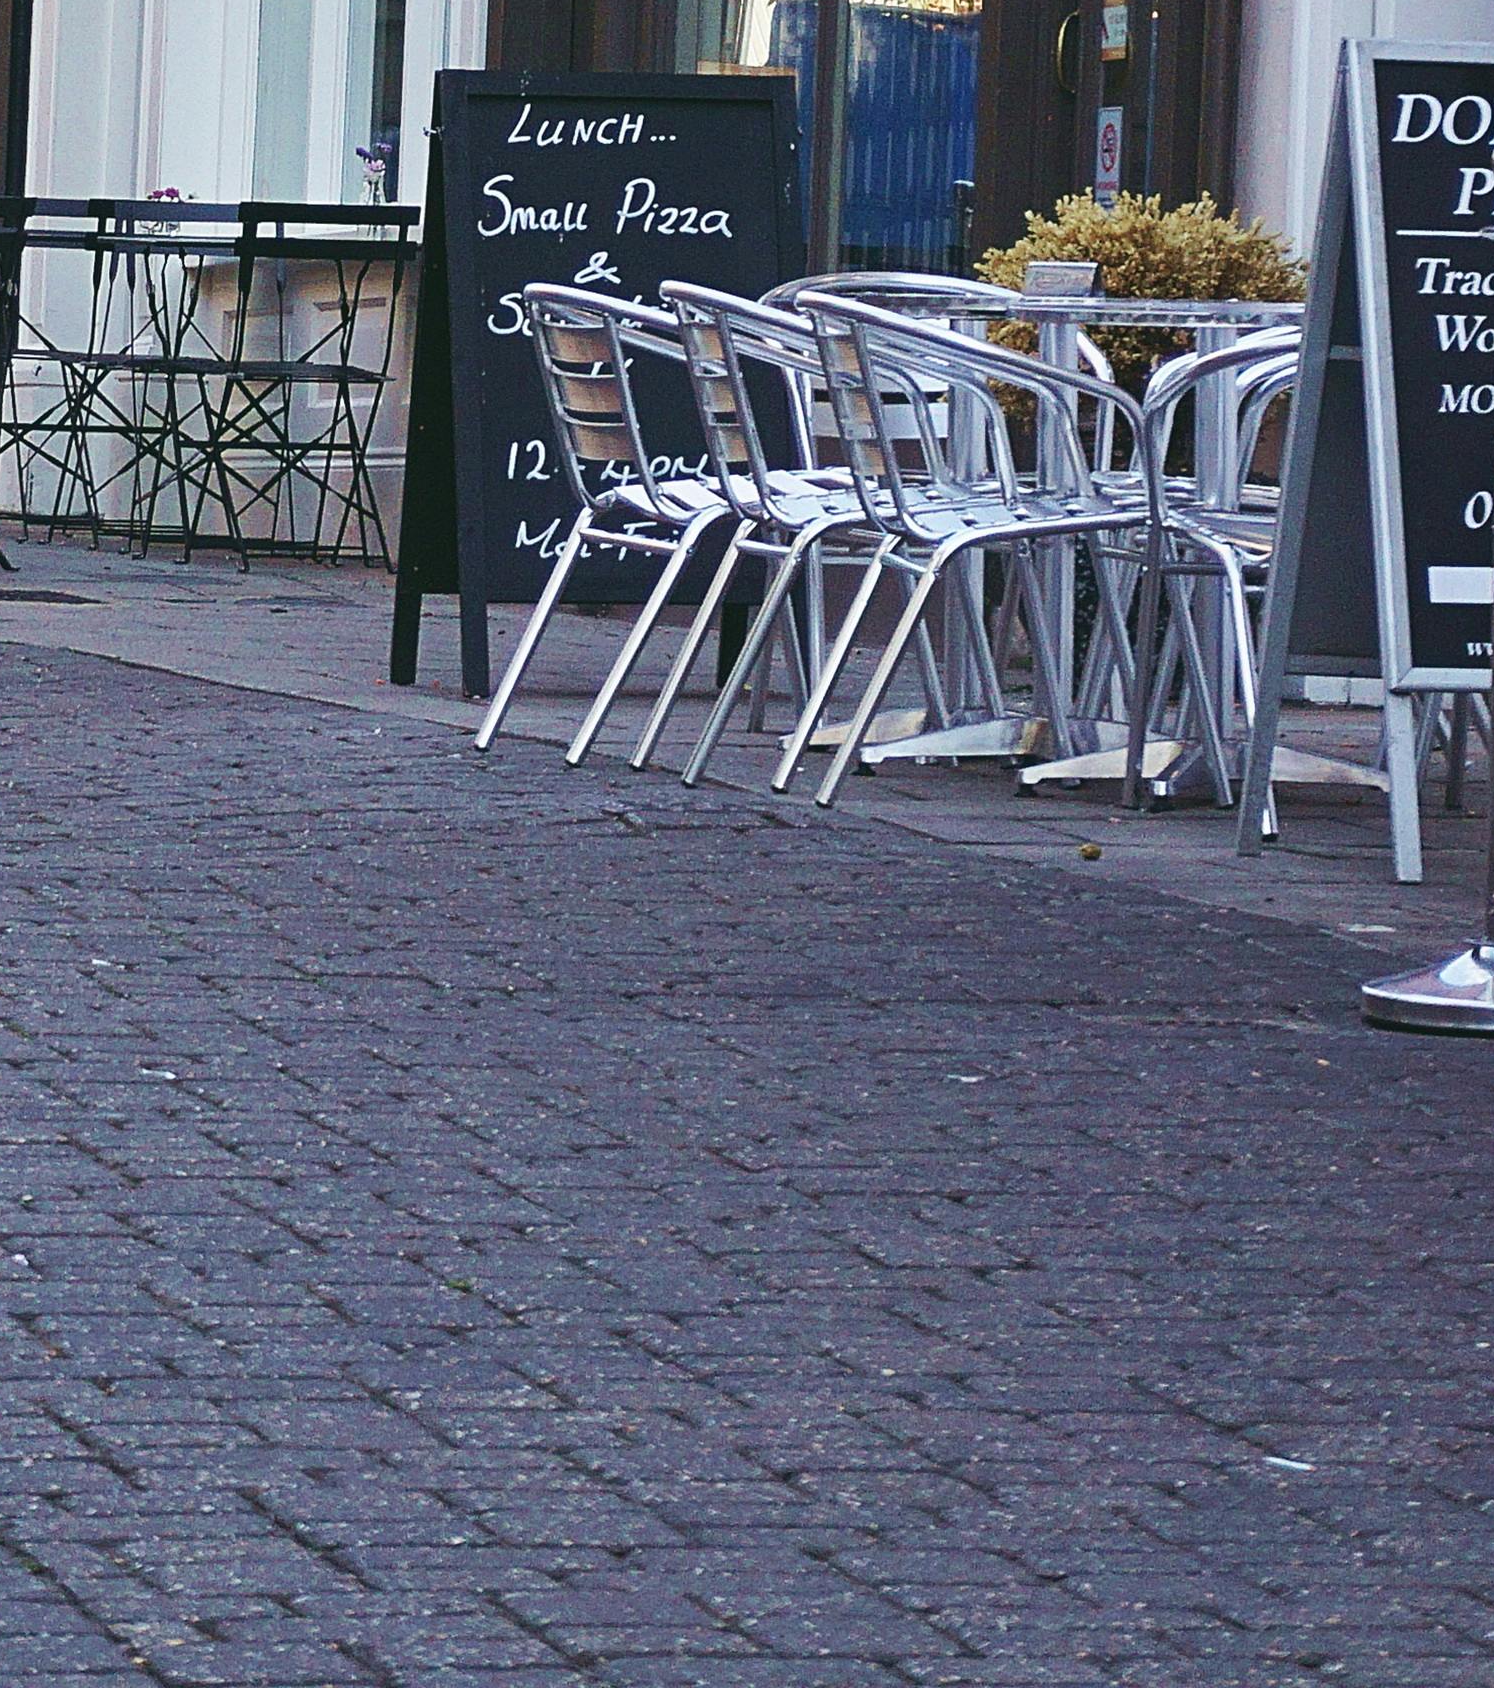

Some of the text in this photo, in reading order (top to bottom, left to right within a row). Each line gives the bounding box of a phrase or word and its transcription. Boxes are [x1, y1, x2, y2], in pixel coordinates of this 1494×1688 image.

[477, 174, 733, 238] Small Pizza
[574, 251, 621, 284] &
